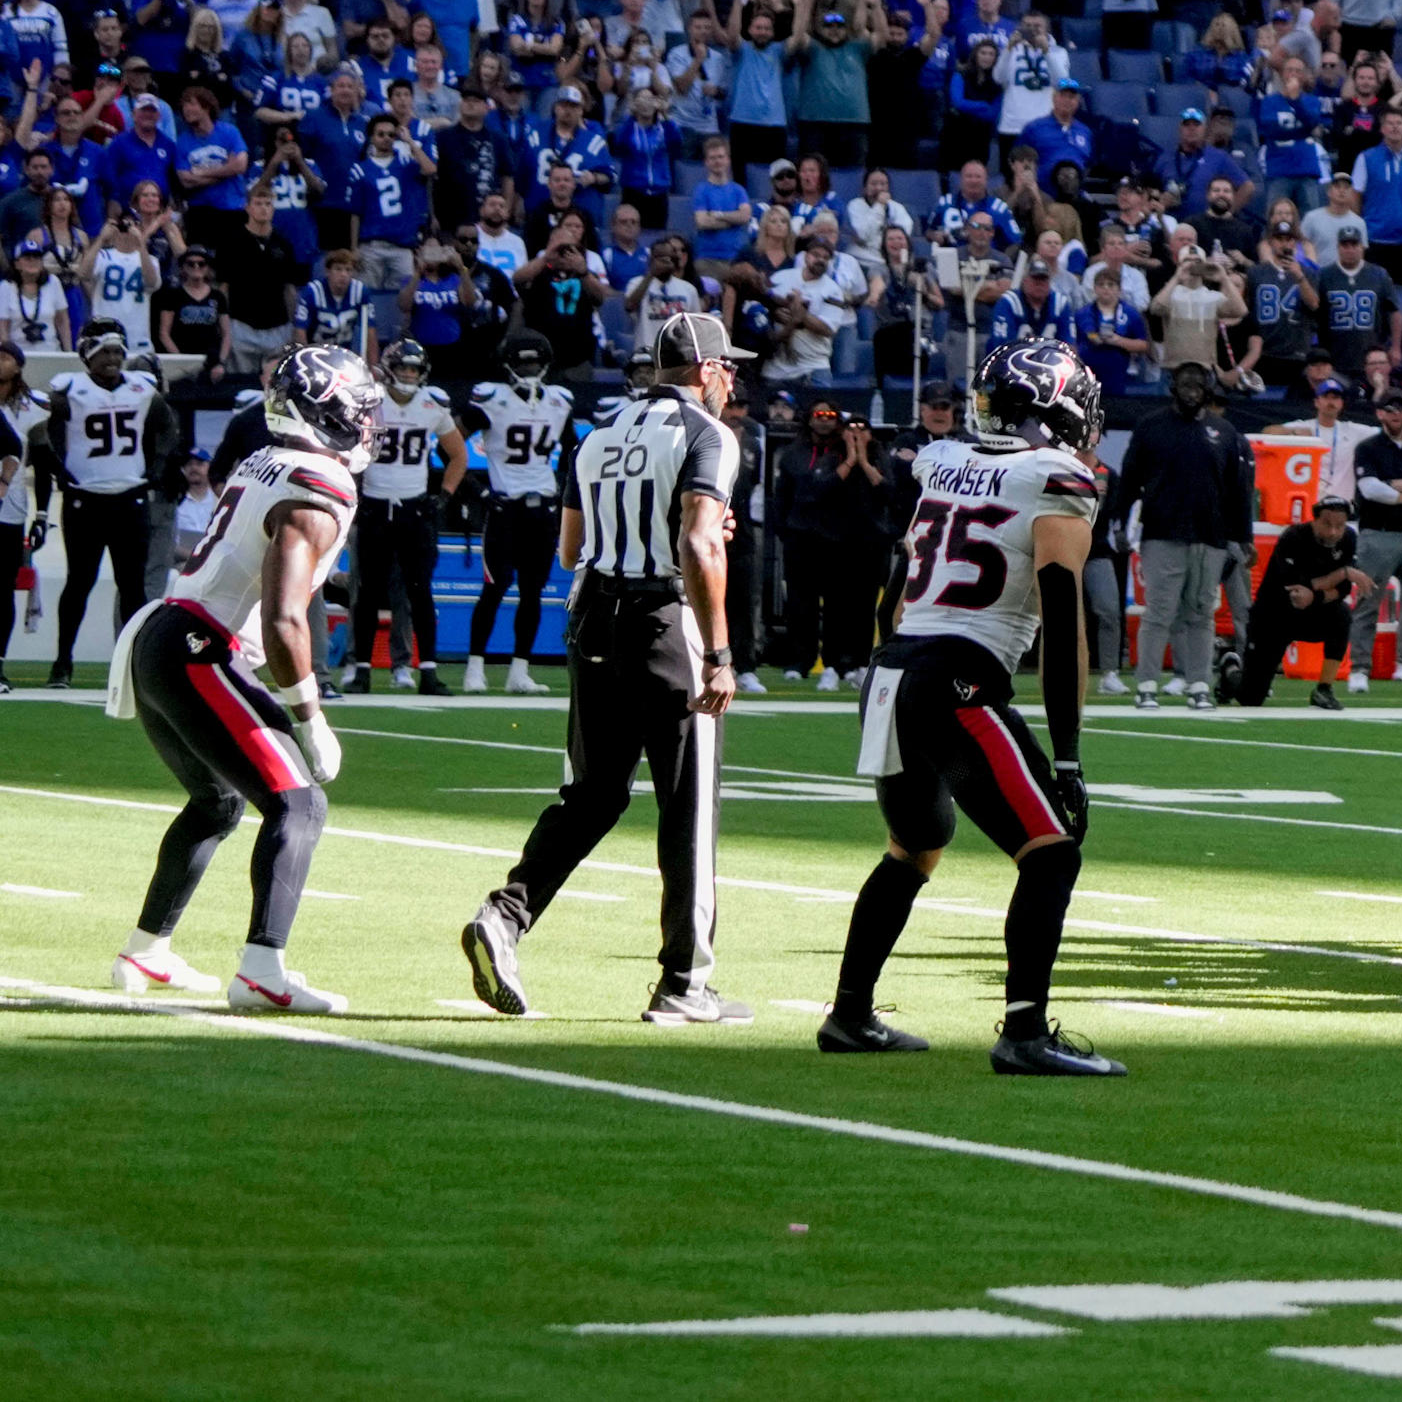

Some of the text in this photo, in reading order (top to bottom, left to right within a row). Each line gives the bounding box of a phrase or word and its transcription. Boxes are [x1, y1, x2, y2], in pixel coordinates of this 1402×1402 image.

[377, 177, 403, 218] 2
[102, 264, 145, 304] 84
[414, 288, 459, 306] COLTS
[1327, 289, 1376, 332] 28
[84, 410, 138, 459] 95
[505, 424, 556, 466] 94
[600, 444, 648, 479] 20
[927, 461, 1007, 498] HANSEN
[1285, 453, 1313, 485] G
